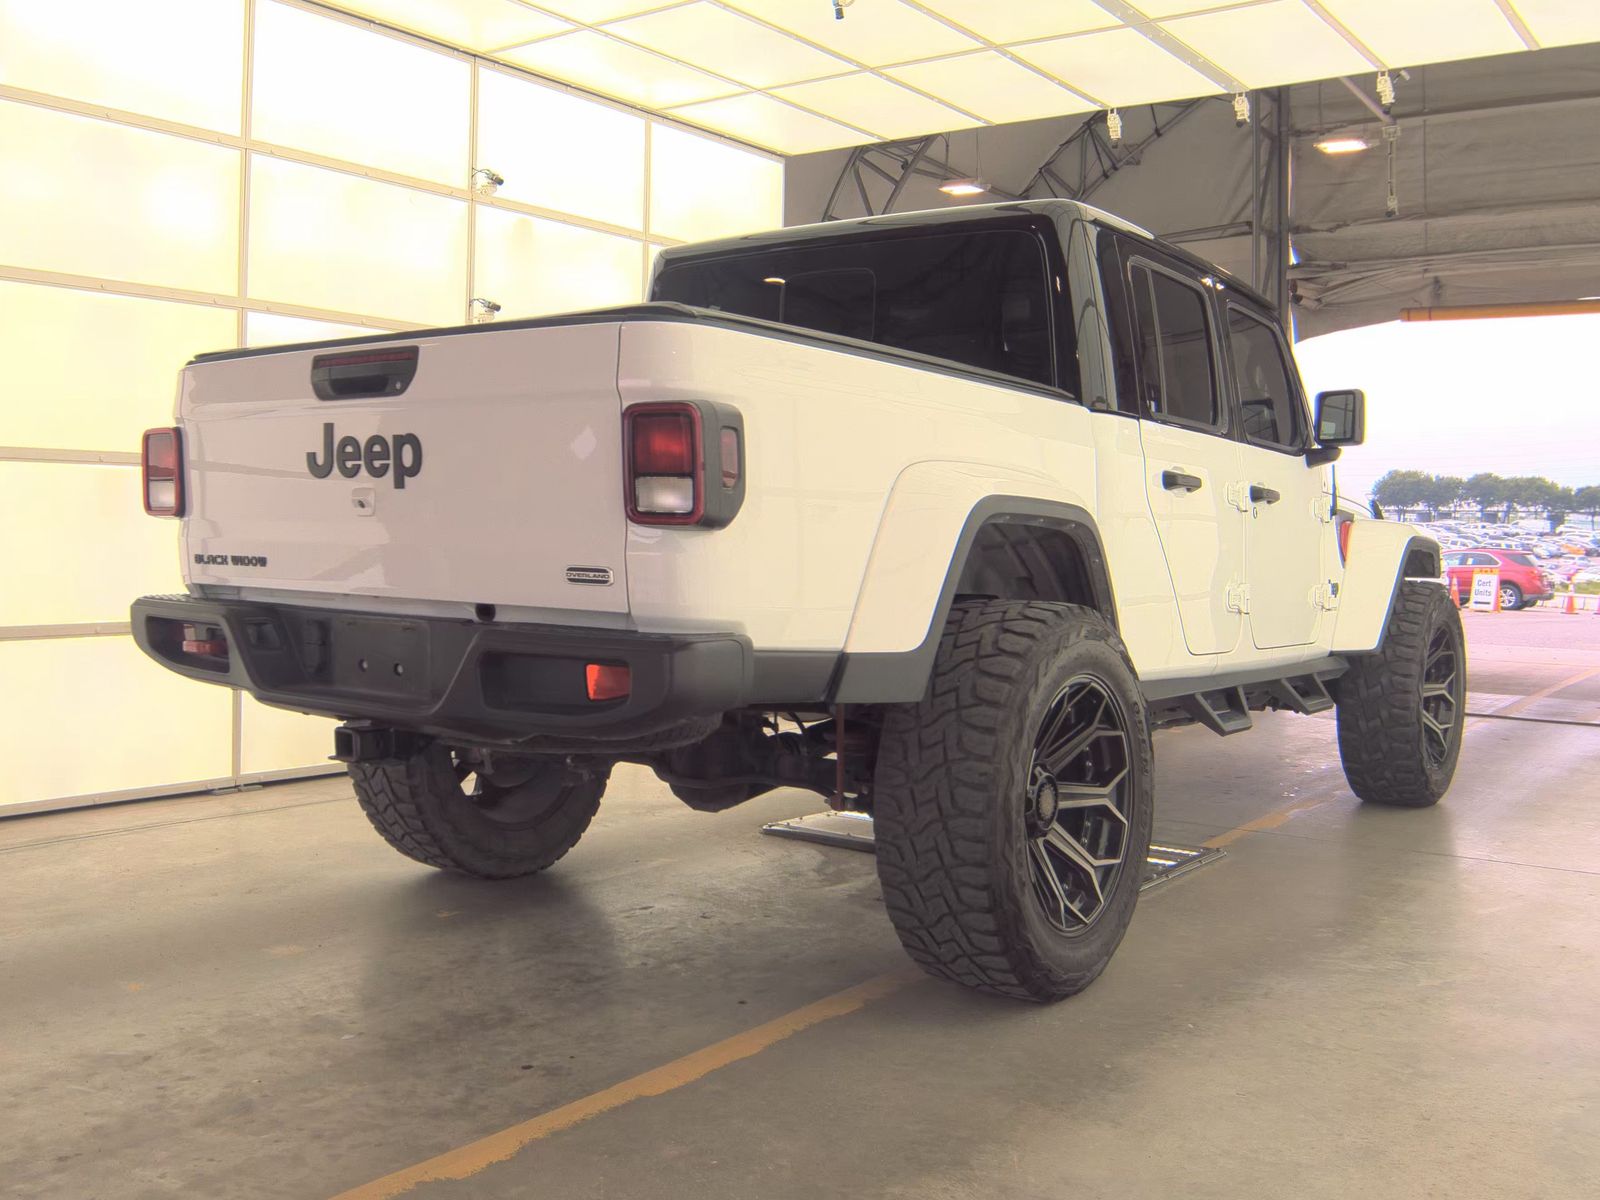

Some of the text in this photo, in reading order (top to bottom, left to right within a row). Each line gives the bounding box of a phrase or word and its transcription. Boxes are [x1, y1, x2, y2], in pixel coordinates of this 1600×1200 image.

[306, 422, 423, 489] Jeep
[194, 553, 268, 567] BLACK WIDOW
[565, 571, 610, 579] OVERLAND
[1477, 579, 1492, 587] Cert
[1474, 589, 1492, 597] Units
